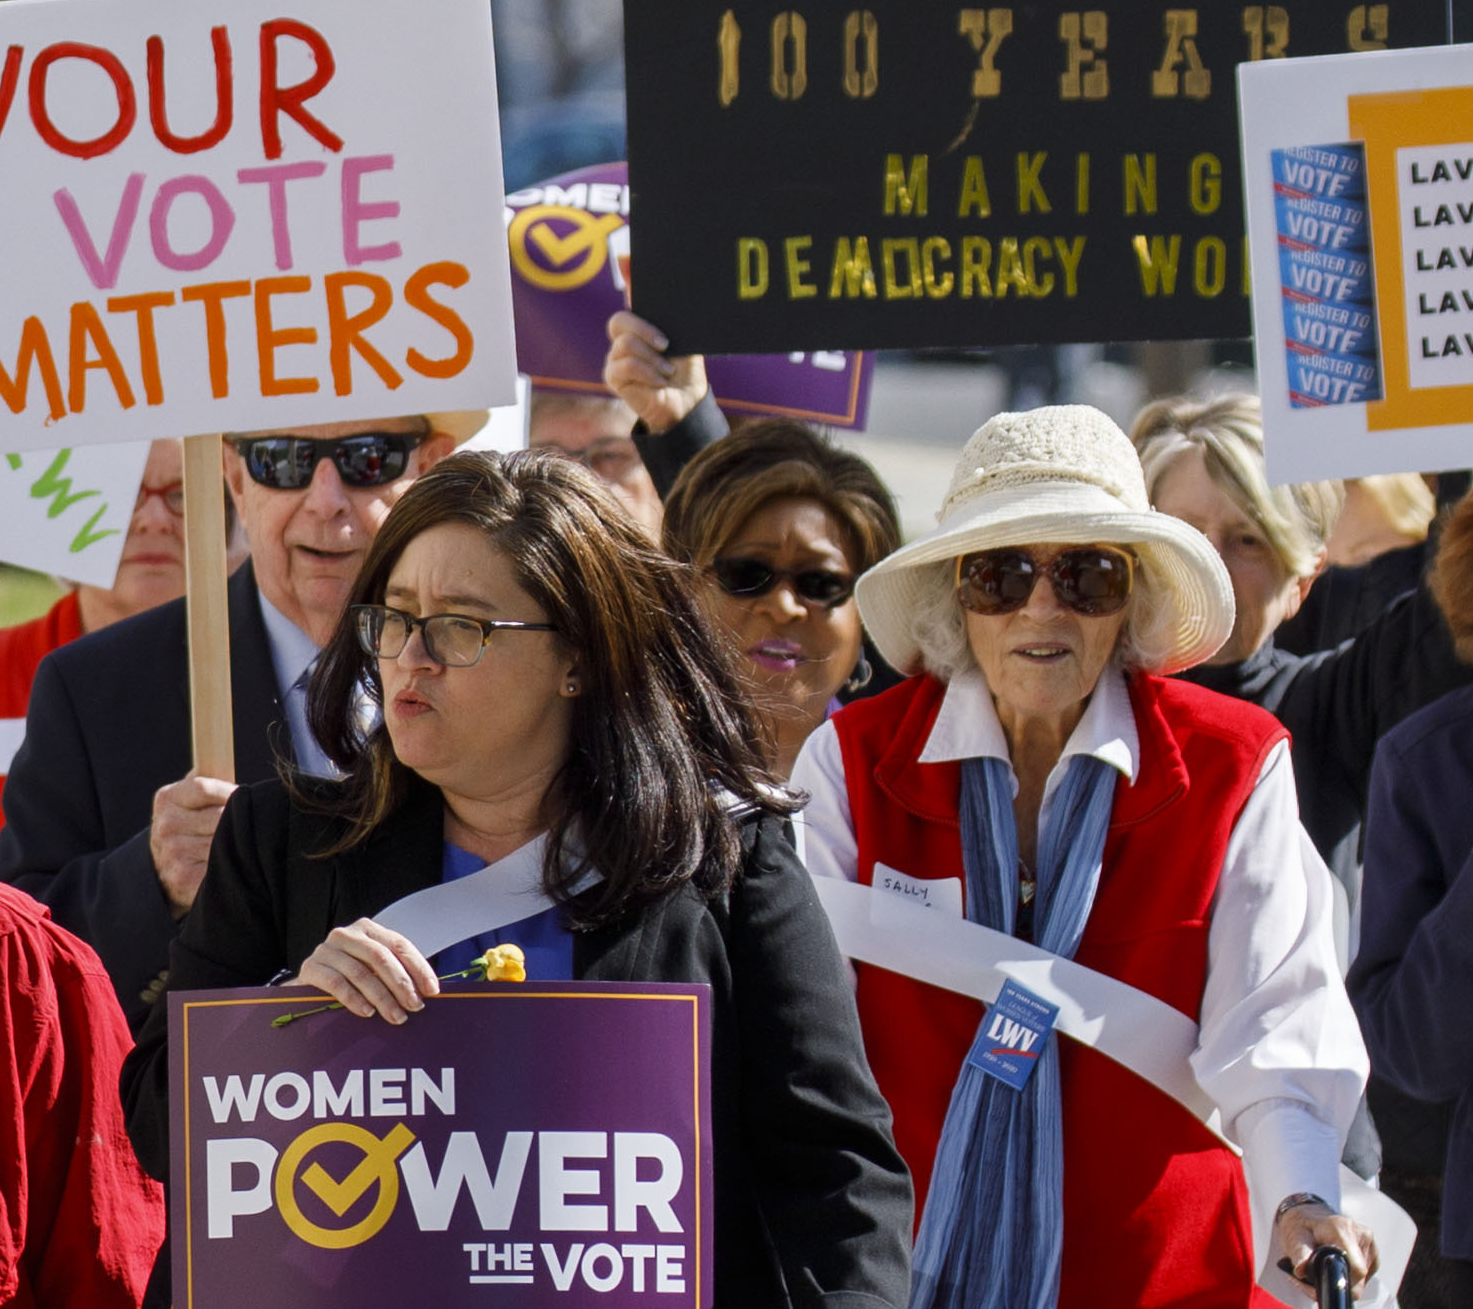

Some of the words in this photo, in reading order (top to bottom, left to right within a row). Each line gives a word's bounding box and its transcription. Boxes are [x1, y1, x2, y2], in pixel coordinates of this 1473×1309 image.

[713, 7, 881, 110] 100
[881, 150, 1224, 217] MAKING
[1284, 159, 1352, 198] VOTE
[51, 153, 402, 289] VOTE
[1287, 211, 1356, 249] VOTE
[736, 235, 1088, 301] DEMOCRACY
[1132, 233, 1251, 298] WO
[1290, 263, 1359, 302] VOTE
[1295, 316, 1363, 354] VOTE
[1299, 368, 1367, 404] VOTE
[884, 878, 928, 900] SALLY
[986, 1013, 1039, 1052] LWV
[202, 1066, 455, 1124] WOMEN
[205, 1121, 685, 1250] POWER
[463, 1242, 533, 1275] THE
[539, 1242, 687, 1294] VOTE
